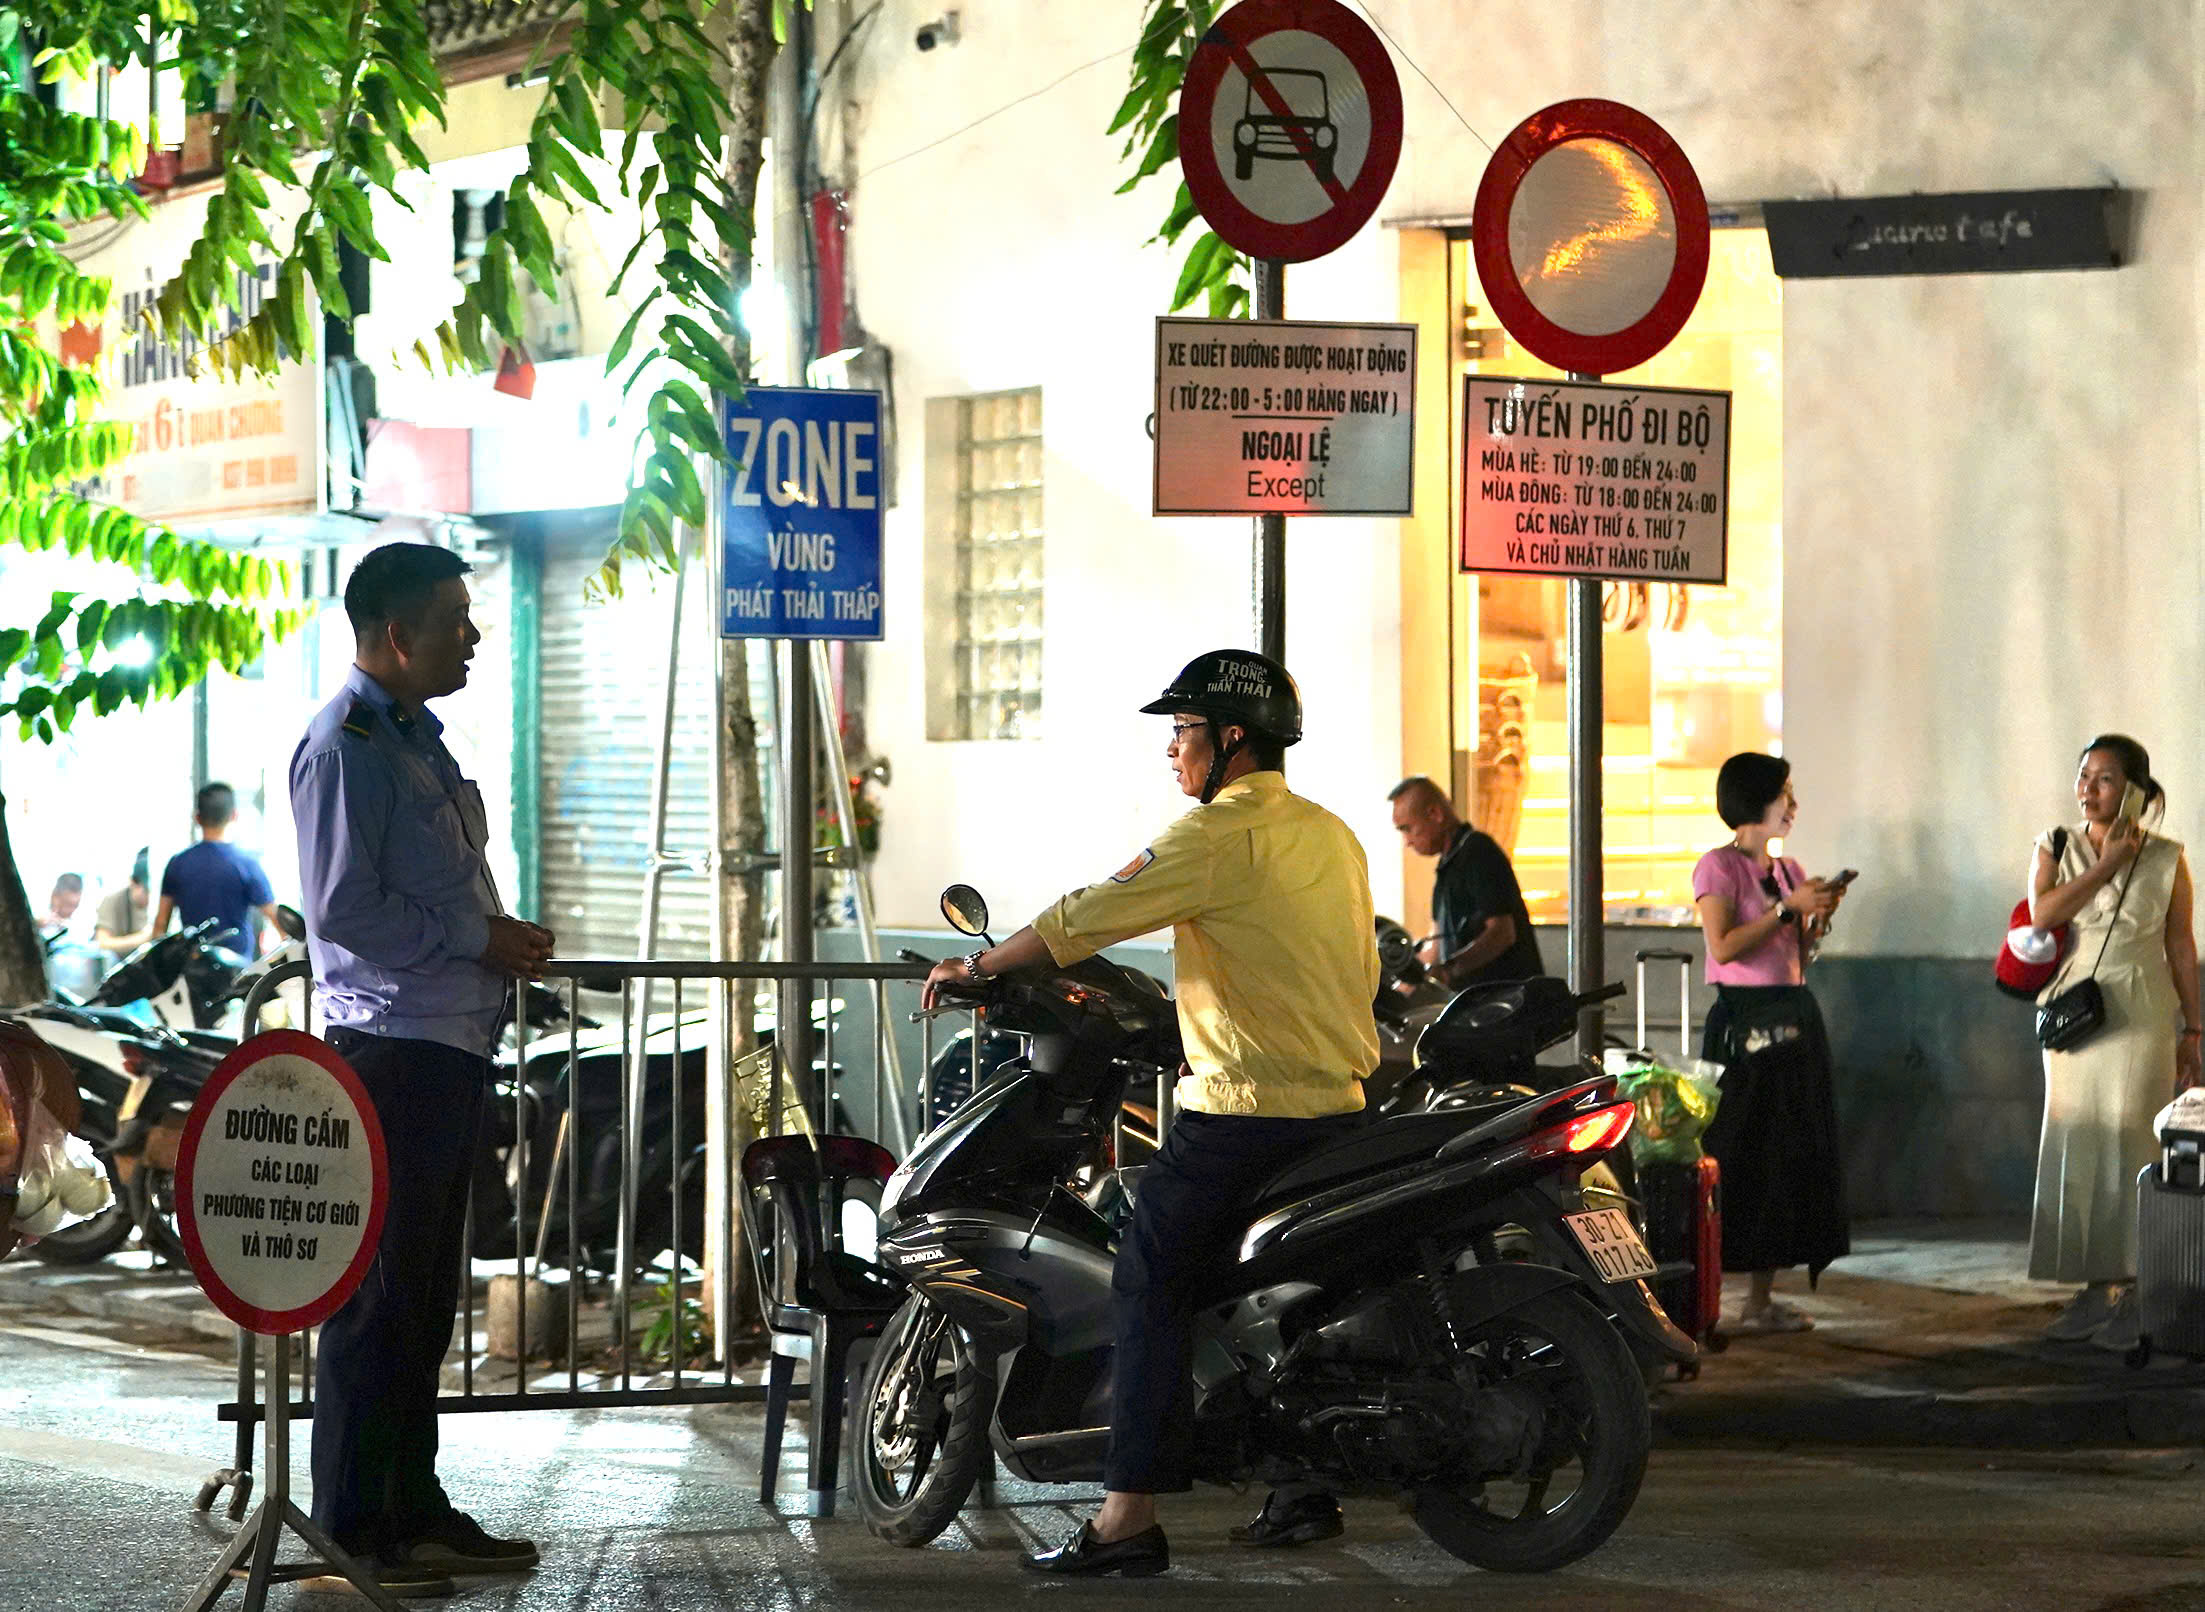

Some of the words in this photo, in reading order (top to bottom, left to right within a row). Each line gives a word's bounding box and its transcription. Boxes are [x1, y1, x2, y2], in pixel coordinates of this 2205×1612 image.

[1168, 343, 1185, 366] XE
[1191, 339, 1226, 367] QUÉT
[1231, 339, 1279, 369] ĐƯỜNG
[1285, 346, 1323, 374] ĐƯỢC
[1327, 348, 1363, 375] HOẠT
[1367, 343, 1406, 376] ĐỘNG
[1307, 383, 1345, 413] HÀNG
[1485, 390, 1570, 439] TUYẾN
[1582, 396, 1639, 441] PHỐ
[1642, 408, 1667, 445] ĐI
[1677, 405, 1710, 454] BỘ
[731, 418, 876, 509] ZONE
[1242, 430, 1302, 466] NGOẠI
[1309, 427, 1330, 467] LỆ
[1482, 446, 1514, 473] MÙA
[1520, 448, 1546, 474] HÈ:
[1553, 450, 1575, 475] TỪ
[1578, 456, 1618, 477] 19:00
[1623, 452, 1651, 480] ĐẾN
[1656, 461, 1696, 482] 24:00
[1247, 470, 1325, 503] Except
[1482, 475, 1514, 502] MÙA
[1519, 479, 1567, 503] ĐÔNG:
[1574, 479, 1594, 507] TỪ
[1599, 487, 1639, 509] 18:00
[1643, 482, 1671, 511] ĐẾN
[1676, 493, 1717, 514] 24:00
[1516, 507, 1545, 534] CÁC
[1550, 510, 1588, 537] NGÀY
[1595, 513, 1623, 538] THỨ
[1645, 515, 1674, 539] THỨ
[1678, 521, 1686, 540] 7
[768, 521, 835, 572] VÙNG
[1507, 538, 1525, 563] VÀ
[1530, 539, 1560, 565] CHỦ
[1565, 546, 1603, 571] NHẬT
[1608, 544, 1647, 569] HÀNG
[726, 582, 774, 618] PHÁT
[782, 583, 825, 619] THẢI
[833, 582, 880, 620] THẤP
[225, 1103, 297, 1144] ĐƯỜNG
[304, 1107, 350, 1149] CẤM
[251, 1155, 282, 1182] CÁC
[286, 1163, 319, 1192] LOẠI
[203, 1193, 264, 1219] PHƯƠNG
[269, 1195, 301, 1226] TIỆN
[306, 1200, 327, 1224] CƠ
[330, 1200, 359, 1226] GIỚI
[1577, 1212, 1629, 1244] 30-Z1
[242, 1233, 260, 1257] VÀ
[266, 1233, 292, 1260] THÔ
[297, 1237, 318, 1260] SƠ
[900, 1249, 945, 1265] HONDA
[1593, 1242, 1653, 1278] 017.46
